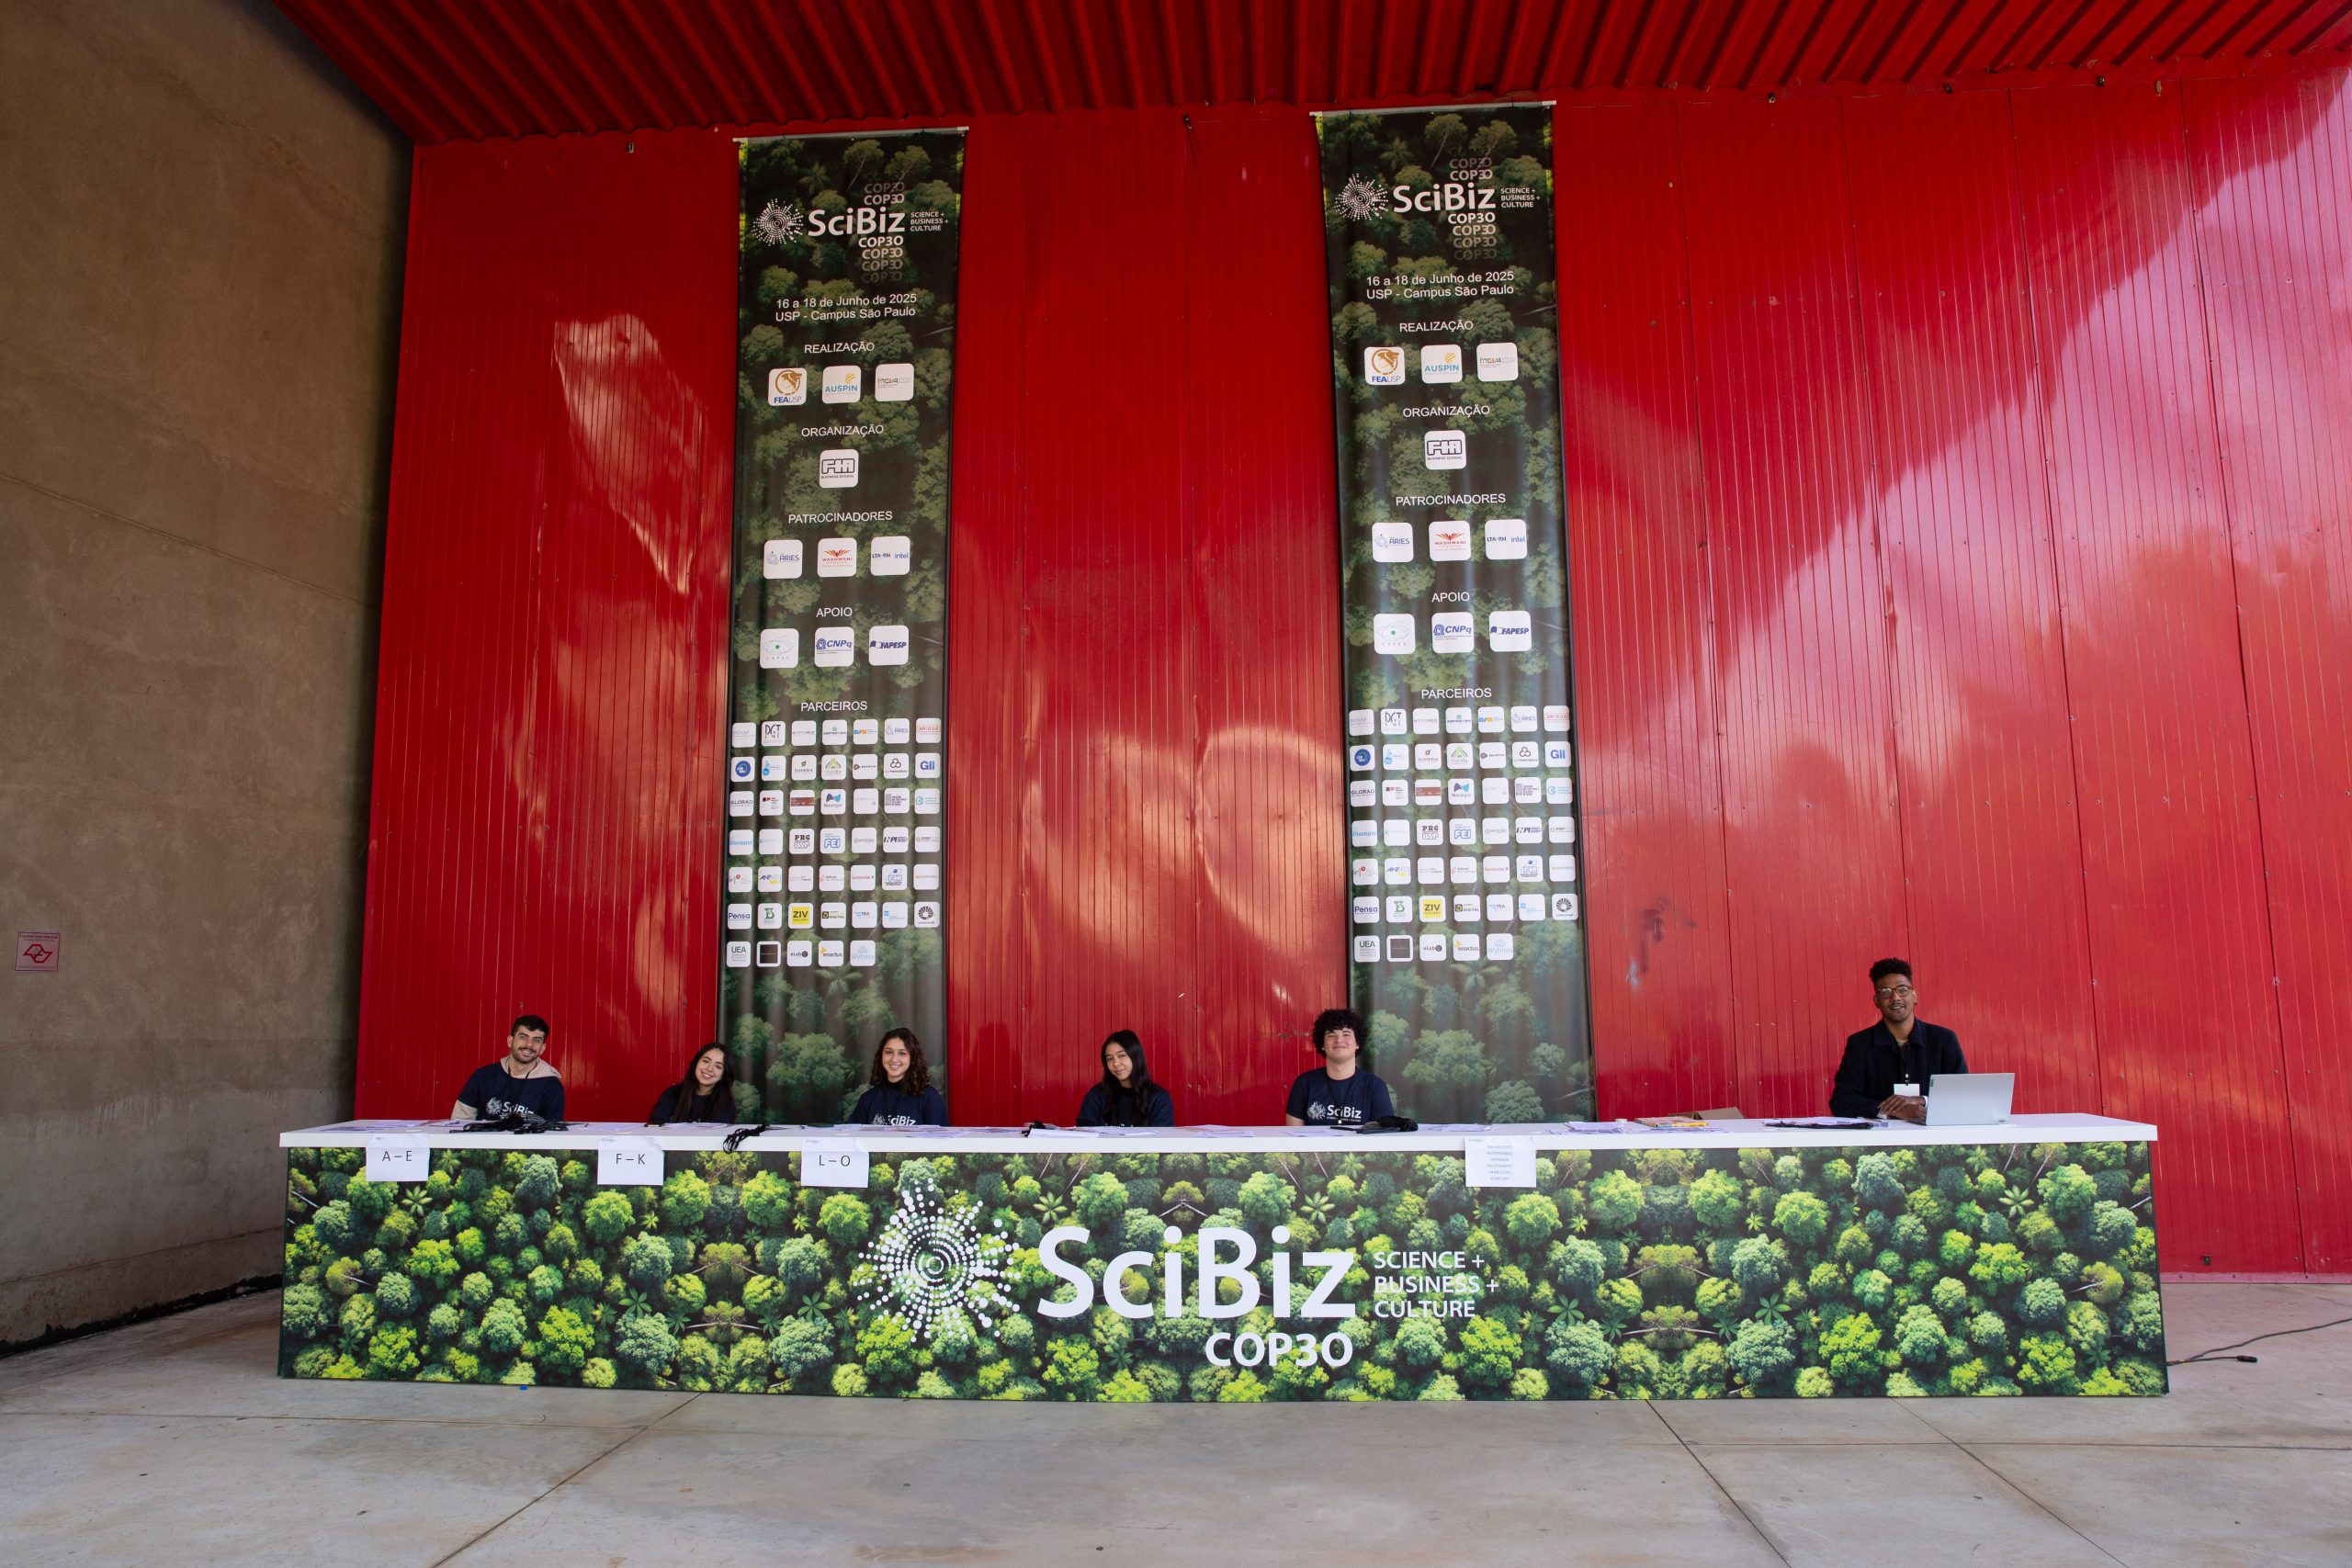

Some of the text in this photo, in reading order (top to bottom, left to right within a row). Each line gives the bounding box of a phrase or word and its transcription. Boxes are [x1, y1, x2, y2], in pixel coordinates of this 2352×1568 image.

[1393, 182, 1497, 213] SciBiz
[808, 207, 906, 237] SciBiz
[1366, 276, 1379, 287] 16
[1395, 276, 1408, 285] 18
[1412, 275, 1426, 285] de
[1430, 274, 1464, 284] Junho
[1467, 272, 1482, 282] de
[1485, 271, 1514, 281] 2025
[1366, 289, 1392, 299] USP
[1403, 288, 1452, 300] Campus
[1454, 286, 1477, 297] São
[1481, 285, 1514, 296] Paulo
[776, 299, 789, 309] 16
[803, 298, 817, 308] 18
[820, 298, 833, 308] de
[836, 296, 870, 307] Junho
[873, 295, 887, 305] de
[889, 293, 917, 304] 2025
[775, 311, 800, 322] USP
[810, 310, 855, 321] Campus
[859, 308, 881, 319] São
[884, 307, 916, 318] Paulo
[1399, 319, 1474, 333] REALIZAÇÃO
[804, 341, 875, 355] REALIZAÇÃO
[825, 385, 858, 393] AUSPIN
[1403, 404, 1490, 418] ORGANIZAÇÃO
[801, 423, 884, 438] ORGANIZAÇÃO
[1396, 493, 1506, 506] PATROCINADORES
[788, 511, 893, 524] PATROCINADORES
[1431, 592, 1470, 603] APOIO
[816, 607, 853, 617] APOIO
[1445, 626, 1472, 635] CNPq
[826, 639, 853, 649] CNPq
[879, 641, 907, 649] FAPESP
[1421, 688, 1492, 699] PARCEIROS
[800, 701, 868, 712] PARCEIROS
[382, 1151, 390, 1161] A
[406, 1151, 412, 1161] E
[616, 1154, 622, 1165] F
[639, 1154, 645, 1165] K
[820, 1155, 825, 1166] L
[841, 1156, 851, 1167] O
[1374, 1251, 1466, 1270] SCIENCE
[1037, 1225, 1356, 1320] SciBiz
[1374, 1275, 1481, 1294] BUSINESS
[1374, 1299, 1476, 1318] CULTURE
[1204, 1332, 1353, 1367] COP30
